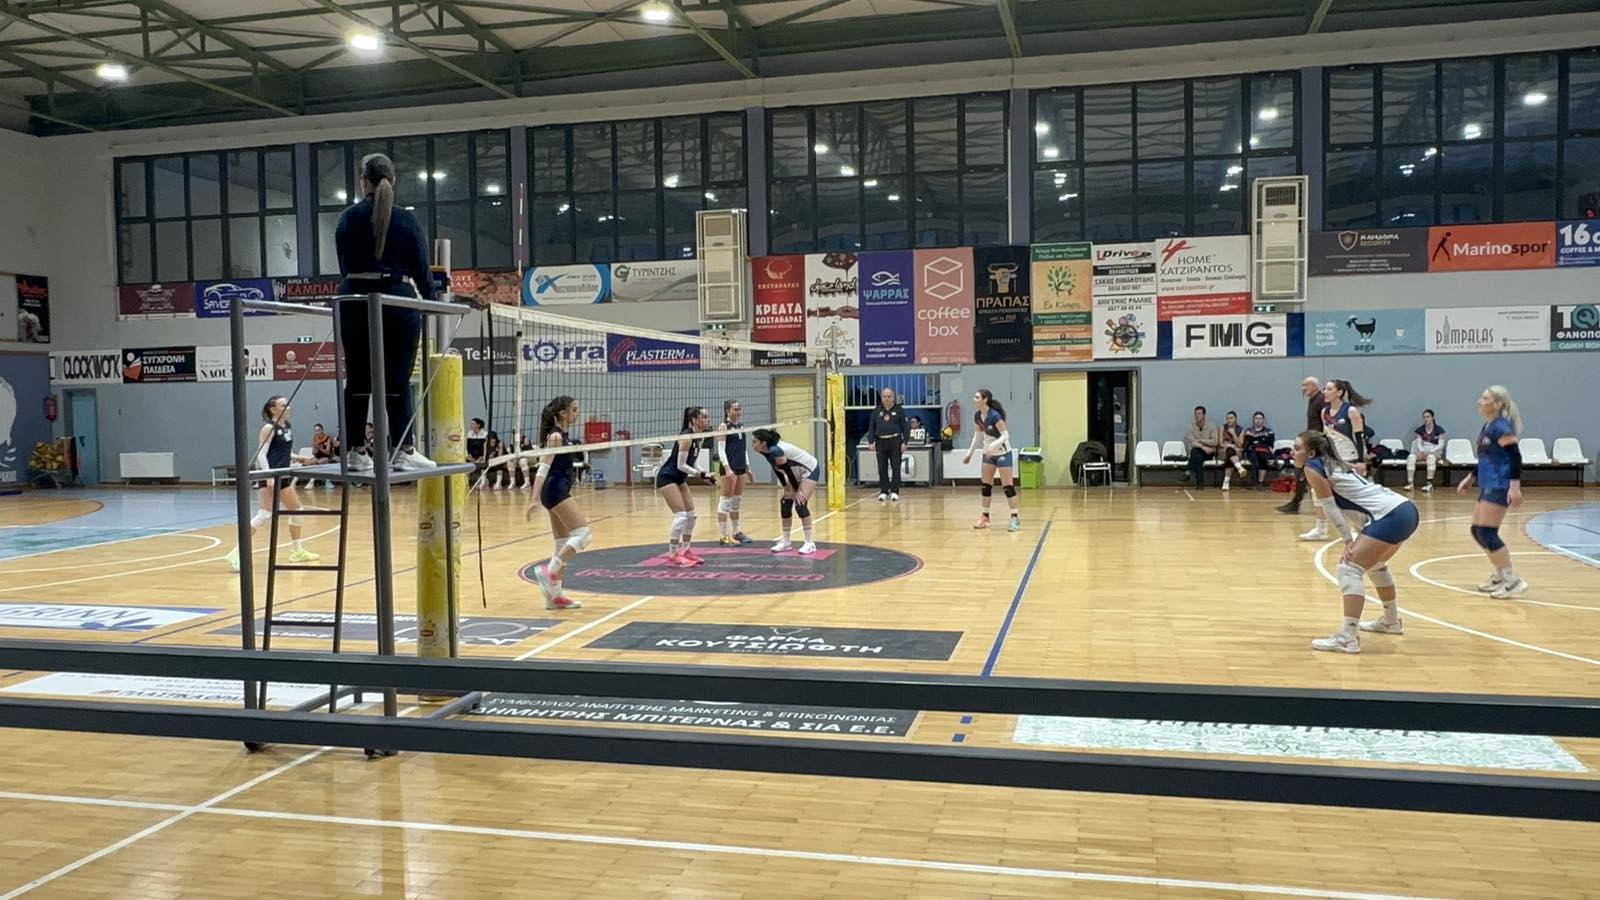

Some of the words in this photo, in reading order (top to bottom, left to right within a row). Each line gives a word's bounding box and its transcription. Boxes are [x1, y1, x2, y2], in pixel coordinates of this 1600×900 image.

[1453, 241, 1549, 256] Marinospor
[1178, 256, 1212, 265] HOME
[1160, 264, 1233, 276] XATZIPANTOS
[863, 288, 910, 300] ΨΑΡΡΑΣ
[756, 302, 803, 315] ΚΡΕΑΤΑ
[976, 295, 1030, 309] ΠΡΑΠΑΣ
[918, 306, 971, 320] coffee
[928, 321, 960, 337] box
[143, 356, 185, 364] ΣΥΓΧΡΟΝΗ
[143, 365, 176, 374] ΠΑΙΔΕΙΑ
[725, 634, 826, 644] ΦΑΡΜΑ
[655, 638, 884, 654] ΚΟΥΤΣΙΩΦΤΗ
[469, 706, 611, 720] ΔΗΜΗΤΡΗΣ
[612, 712, 767, 729] ΜΠΙΤΕΡΝΑΣ
[770, 721, 792, 730] &
[798, 722, 842, 733] ΣΙΑ
[848, 724, 898, 735] Ε.Ε.
[667, 705, 760, 718] MARKETING
[762, 710, 775, 718] &
[778, 711, 898, 724] ΕΠΙΚΟΙΝΩΝΙΑΣ
